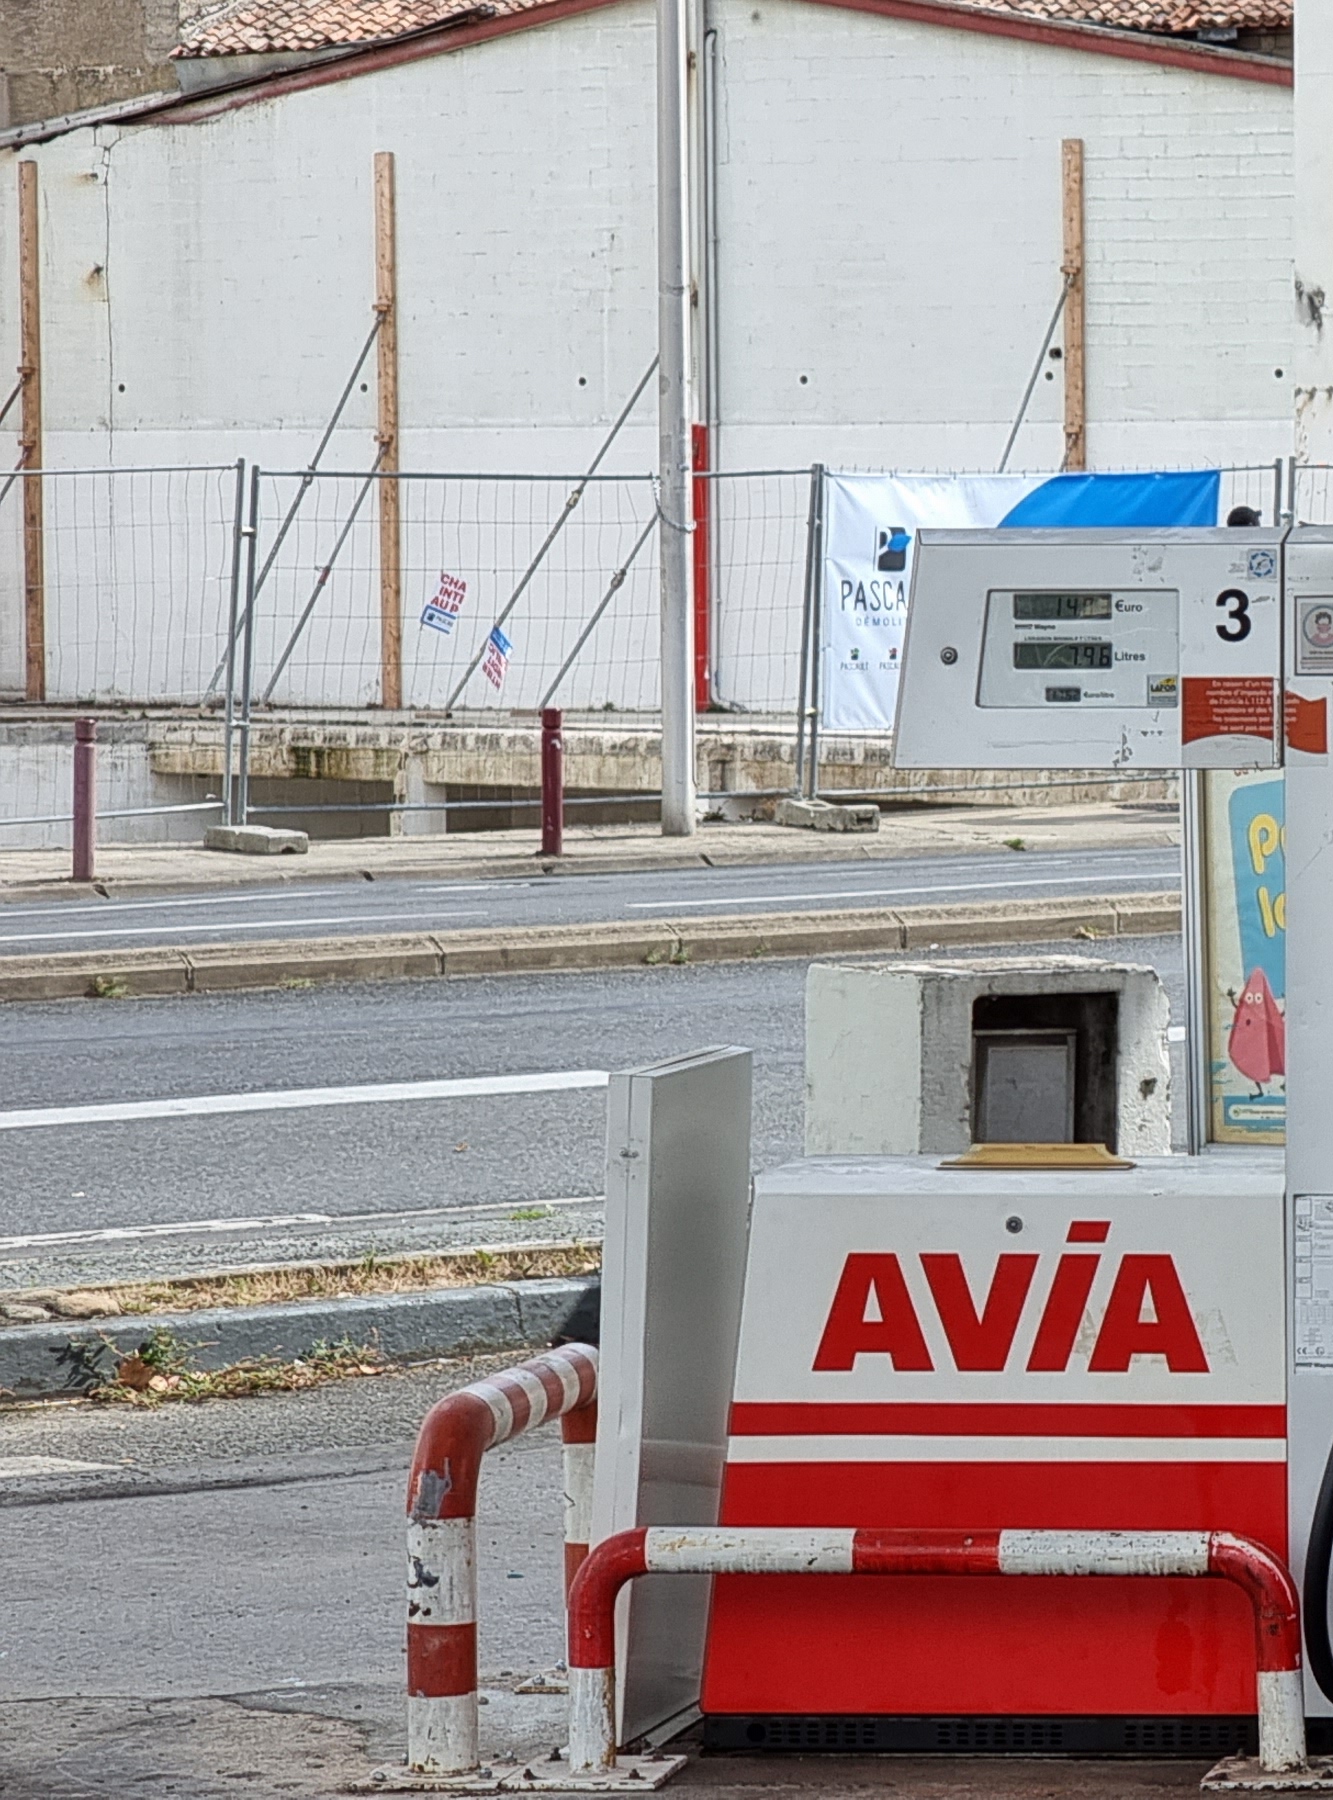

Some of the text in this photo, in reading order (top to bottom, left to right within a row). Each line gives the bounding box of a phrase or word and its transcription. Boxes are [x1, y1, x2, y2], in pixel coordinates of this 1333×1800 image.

[440, 573, 467, 593] CHA
[840, 579, 906, 612] PASCA
[855, 616, 904, 627] DÉMOLI
[1215, 589, 1252, 643] 3
[1114, 651, 1147, 662] Litres
[811, 1220, 1211, 1374] AVIA
